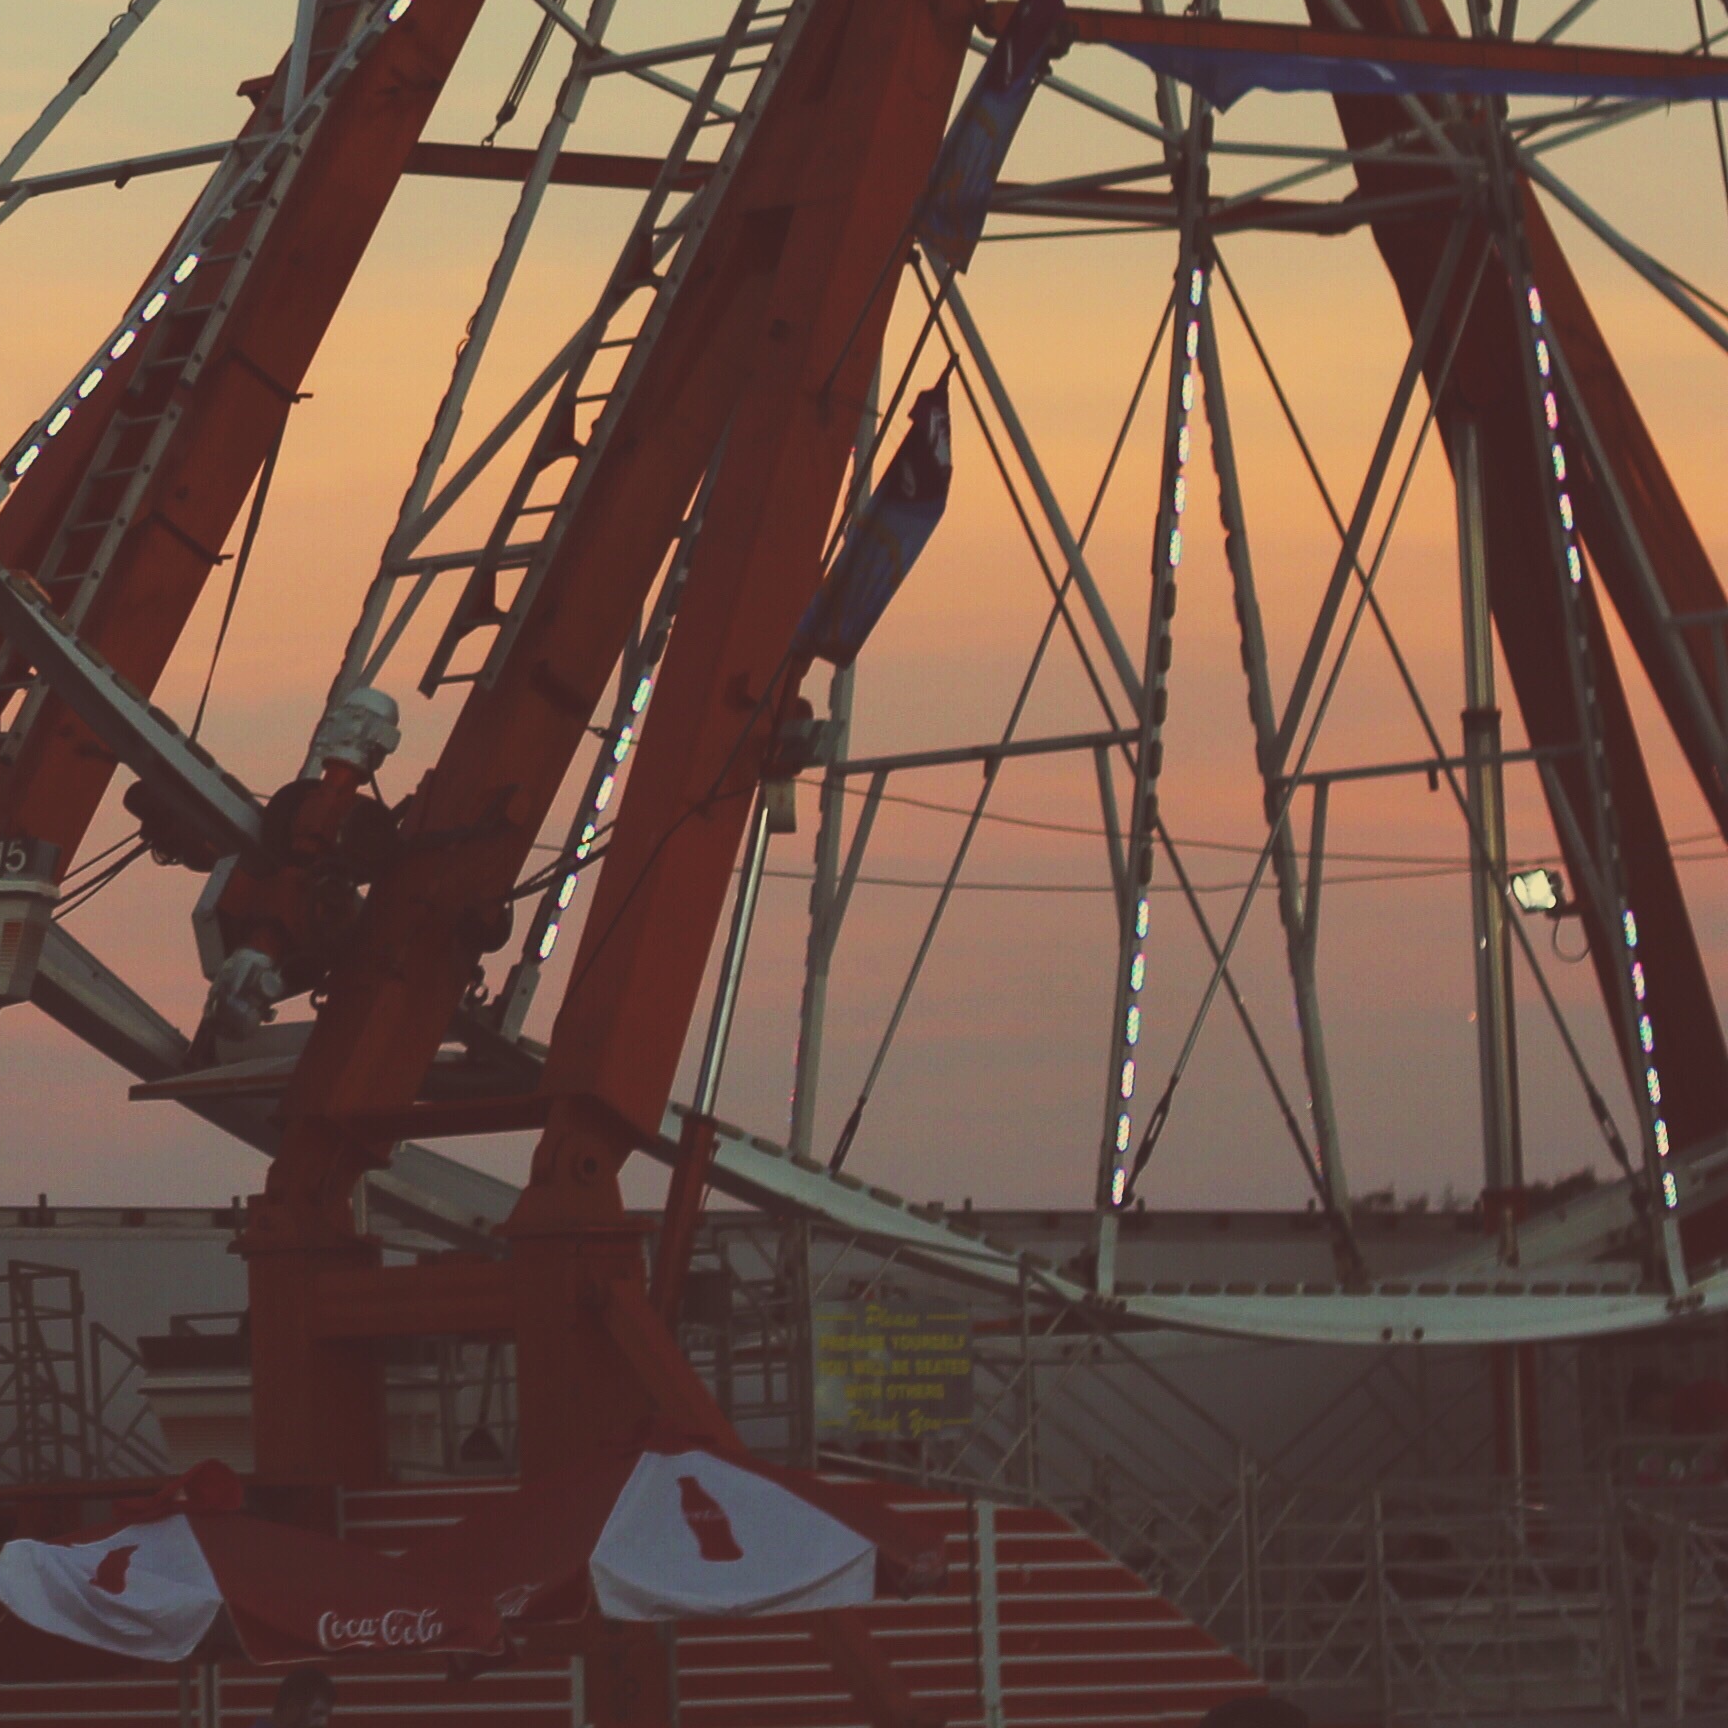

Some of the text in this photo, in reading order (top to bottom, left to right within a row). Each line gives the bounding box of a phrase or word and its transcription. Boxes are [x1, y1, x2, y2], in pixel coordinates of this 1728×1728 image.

[891, 1334, 966, 1351] YOURSELF
[886, 1383, 945, 1400] OTHERS
[908, 1408, 942, 1438] You
[317, 1608, 442, 1652] Coca-Cola
